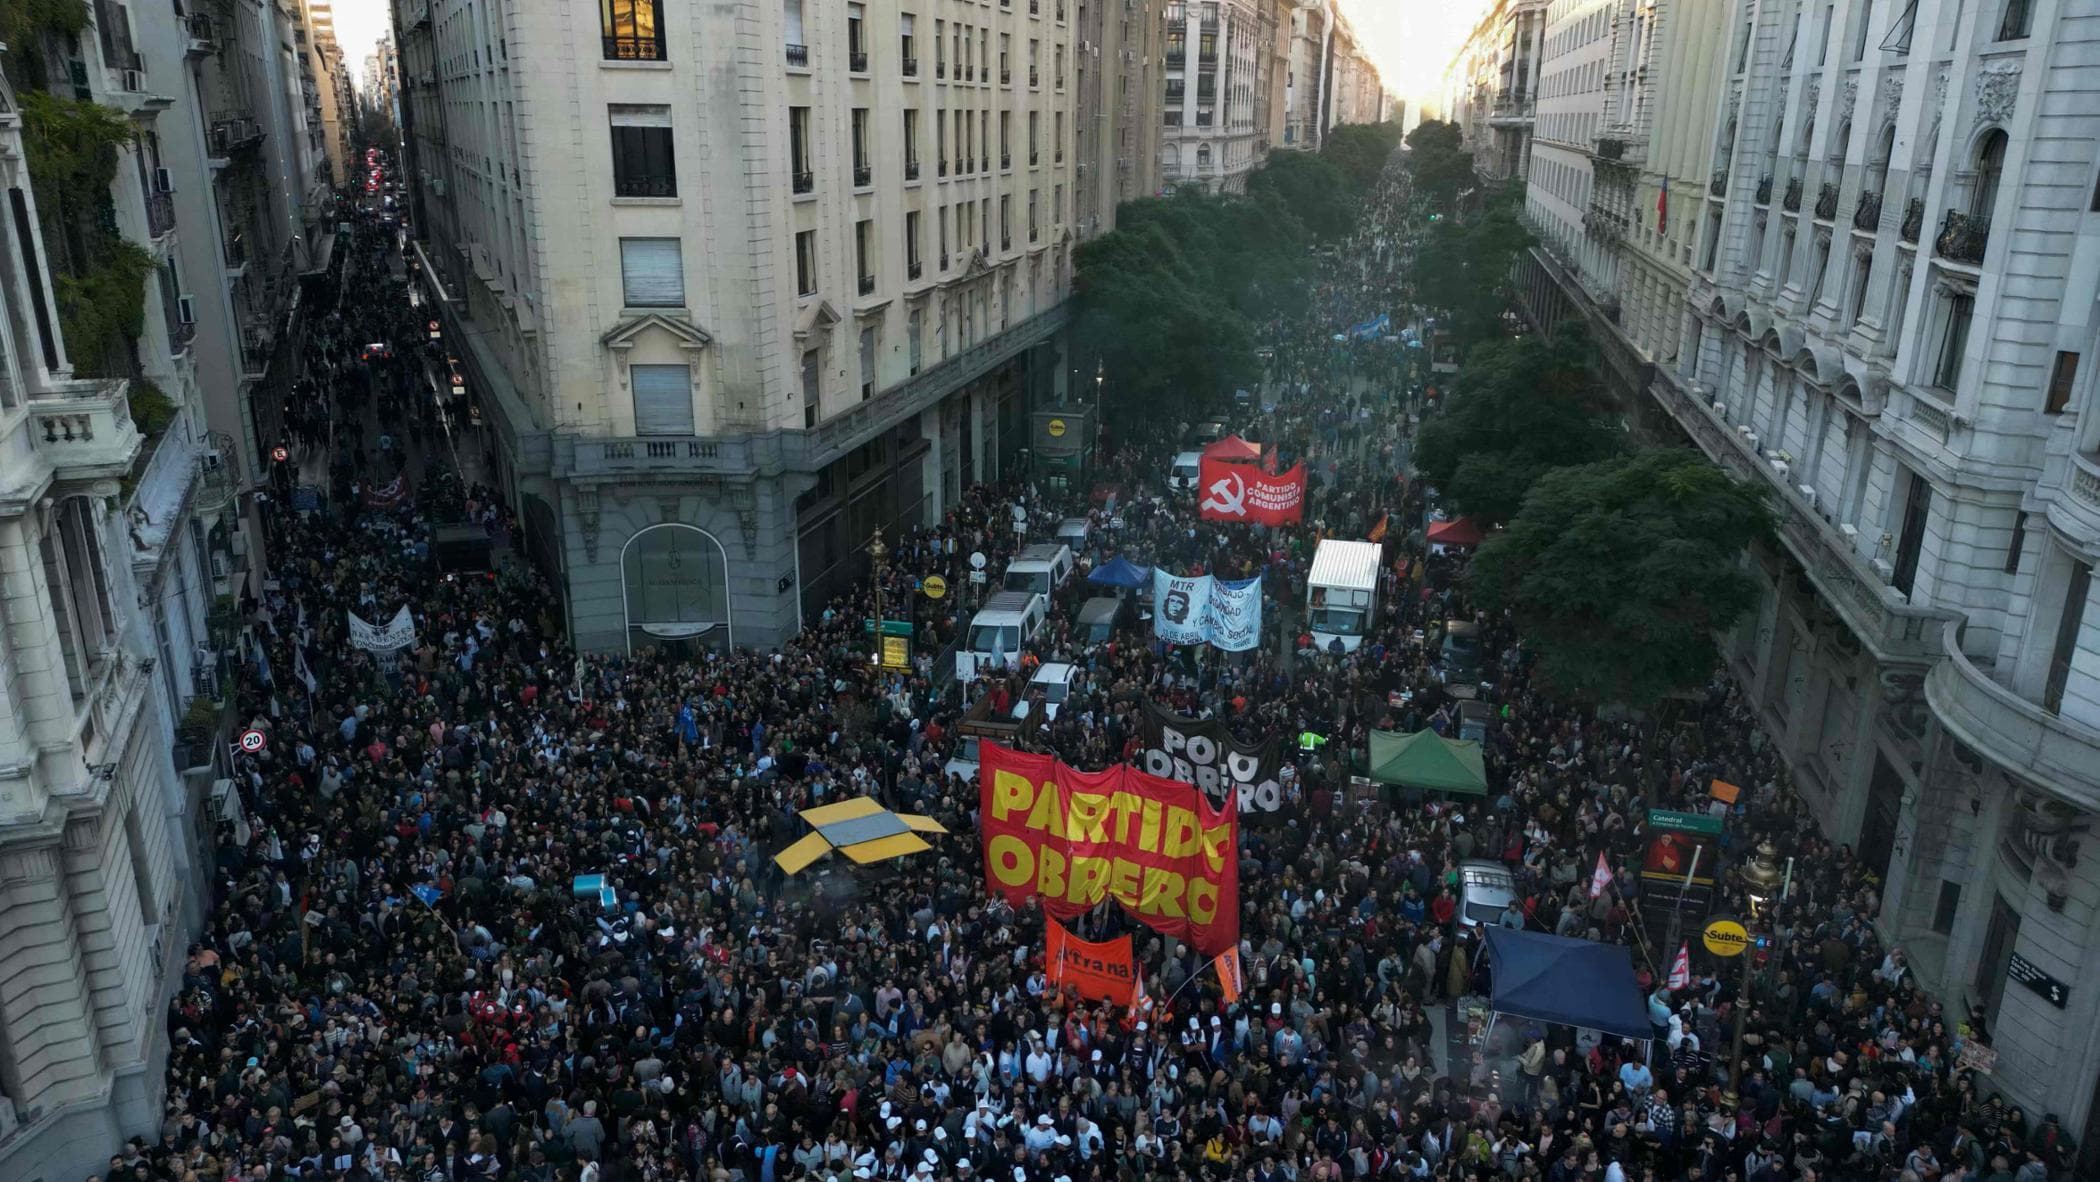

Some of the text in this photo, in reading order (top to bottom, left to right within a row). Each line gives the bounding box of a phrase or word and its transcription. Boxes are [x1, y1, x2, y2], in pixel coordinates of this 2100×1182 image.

[1256, 481, 1296, 494] PARTIDO
[1248, 497, 1299, 510] ARGENTINO
[1170, 579, 1194, 591] MTR
[245, 736, 260, 746] 20
[1146, 749, 1281, 813] OBRERO
[992, 769, 1231, 873] PARTIDO
[1653, 815, 1682, 824] Catedral
[988, 834, 1219, 925] OBRERO
[1709, 930, 1743, 941] Subte
